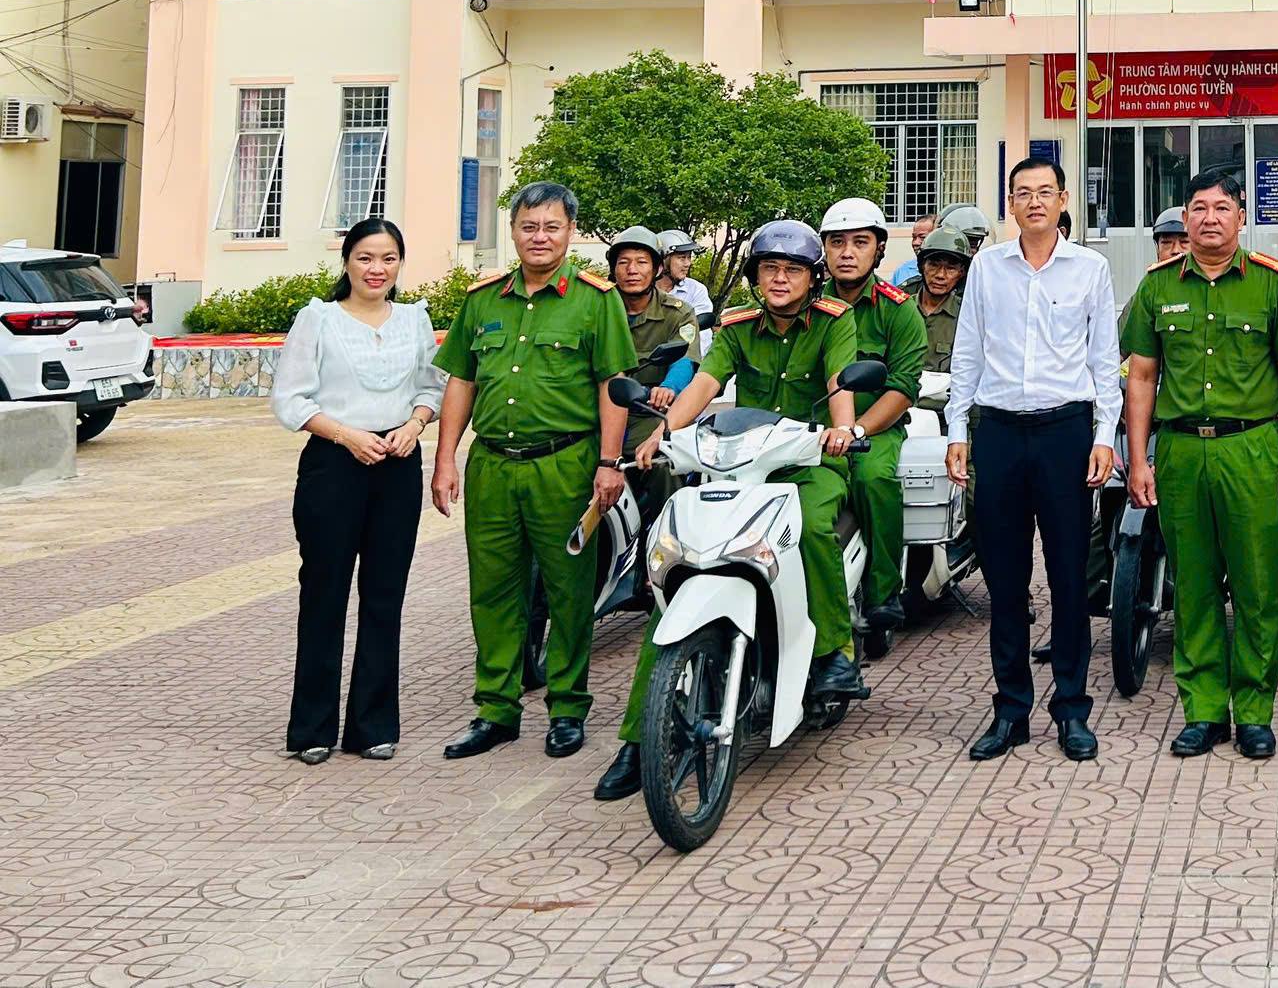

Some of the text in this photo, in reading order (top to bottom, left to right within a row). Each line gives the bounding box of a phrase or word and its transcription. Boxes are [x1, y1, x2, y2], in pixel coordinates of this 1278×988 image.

[1119, 65, 1155, 77] TRUNG
[1158, 62, 1180, 76] TÂM
[1183, 64, 1212, 78] PHỤC
[1214, 63, 1229, 78] VỤ
[1231, 60, 1261, 75] HÀNH
[1119, 78, 1234, 96] PHƯỜNG LONG TUYỀN
[1119, 99, 1210, 111] Hành chính phục vụ
